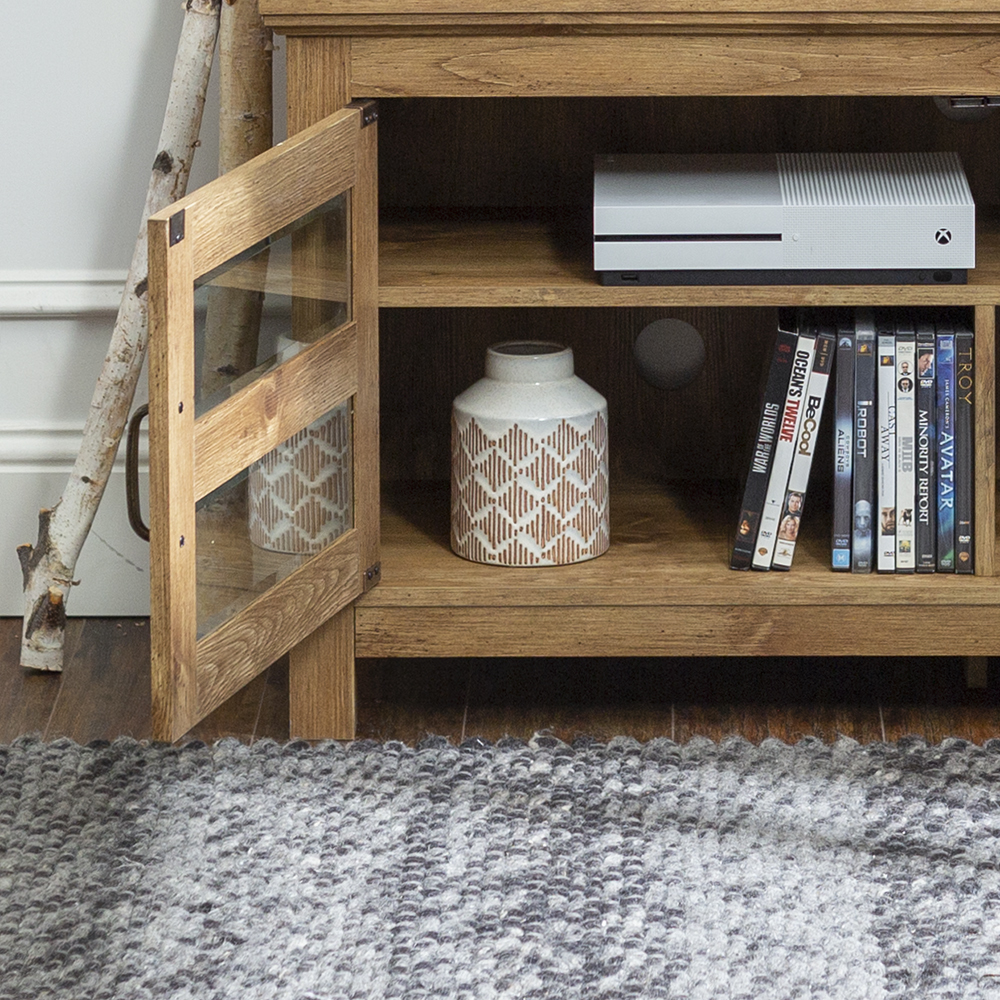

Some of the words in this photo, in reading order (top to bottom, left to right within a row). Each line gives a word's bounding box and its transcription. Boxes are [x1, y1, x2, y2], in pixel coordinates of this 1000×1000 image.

[789, 350, 810, 398] OCEAN'S
[957, 347, 973, 405] TROY
[758, 402, 780, 444] WORLDS
[780, 399, 801, 443] TWELVE
[880, 425, 891, 463] AWAY
[918, 409, 929, 475] MINORITY
[752, 450, 771, 474] WAR
[837, 429, 845, 473] ALIENS
[939, 431, 954, 511] AVATAR
[918, 478, 929, 526] REPORT
